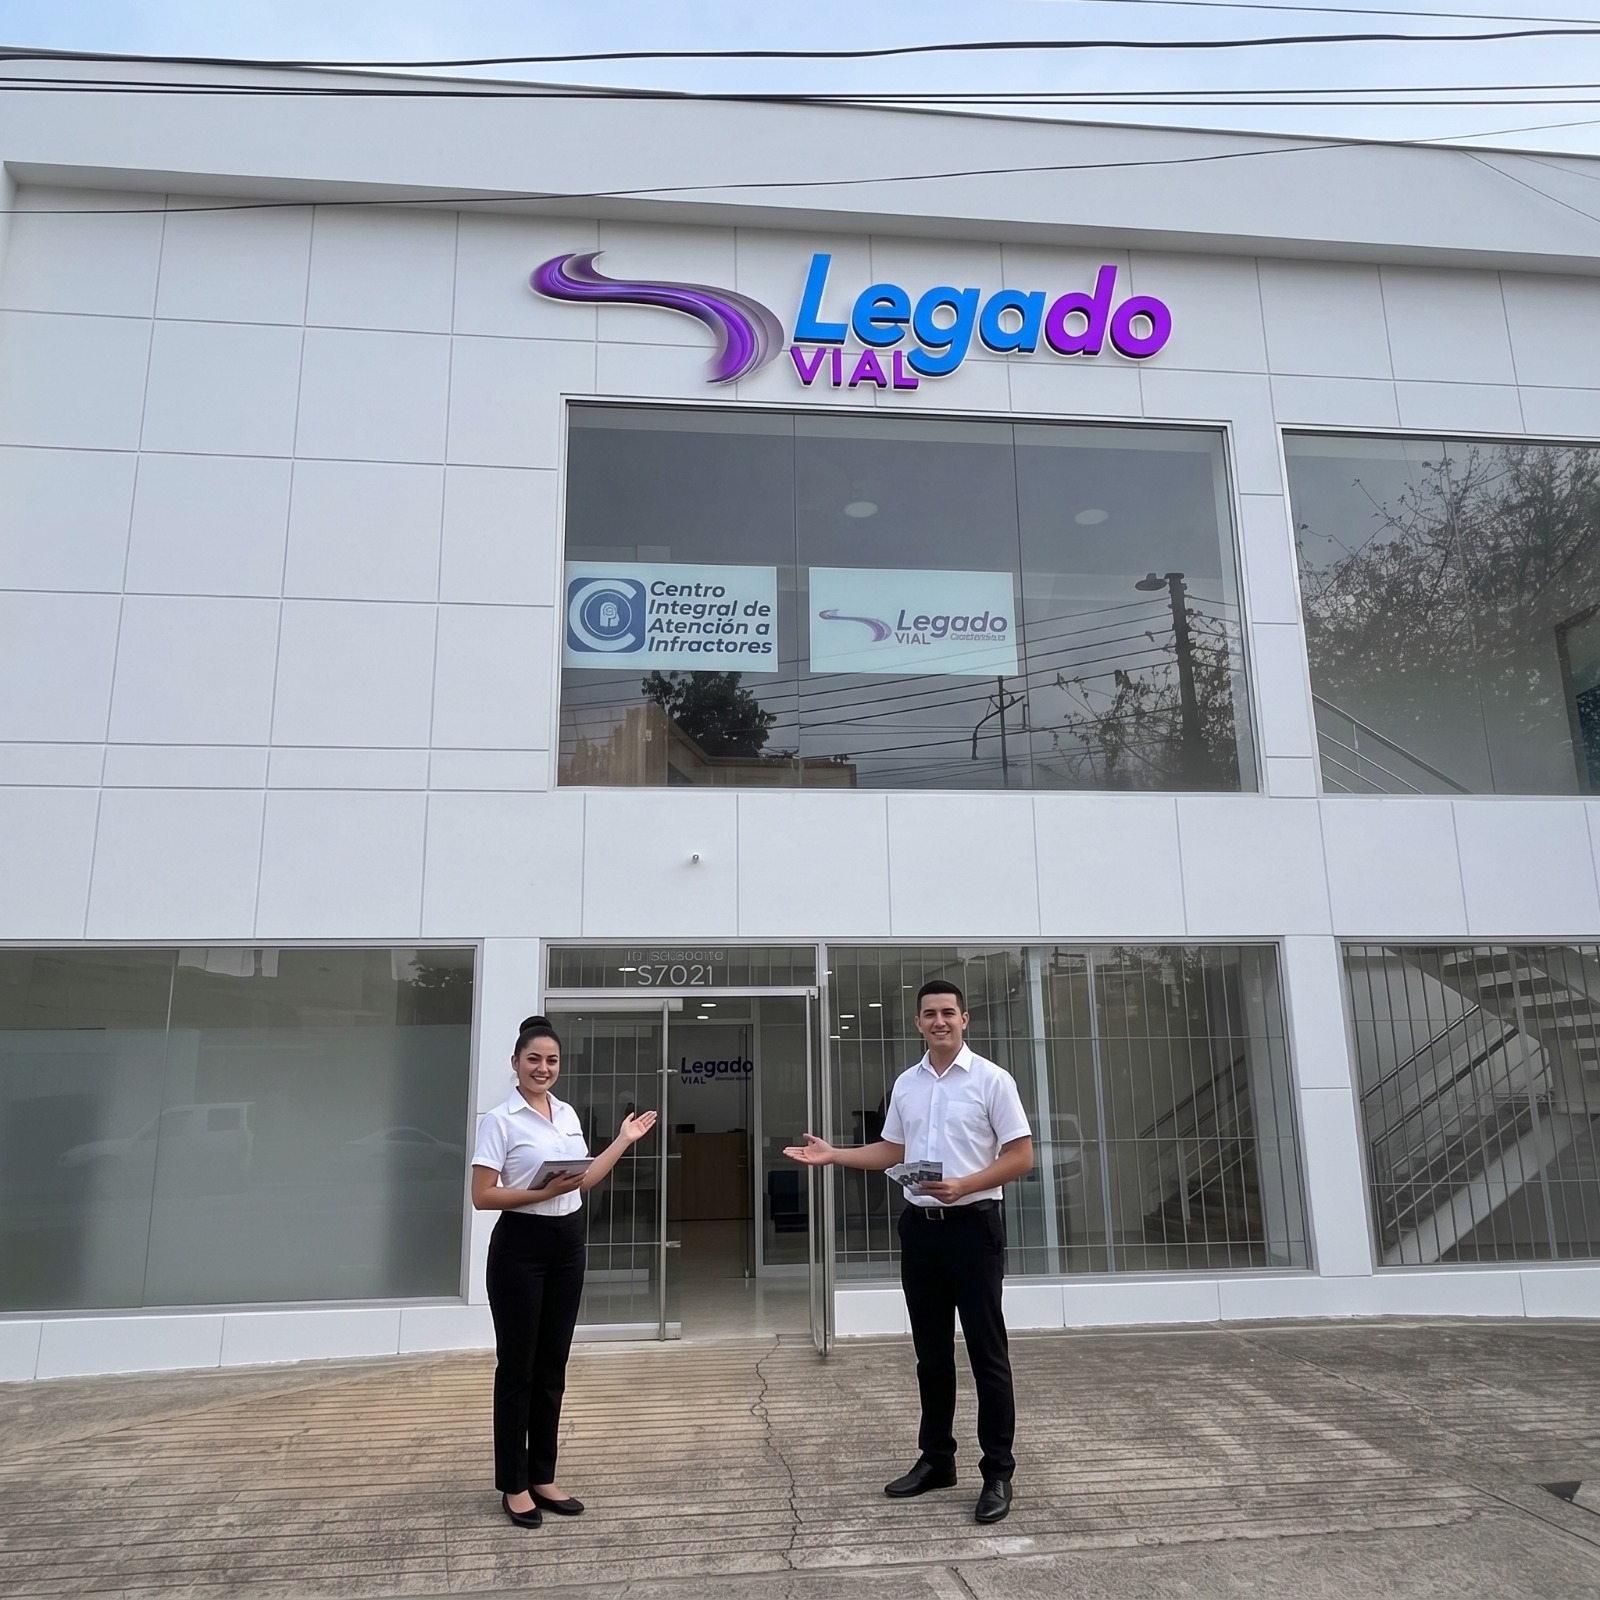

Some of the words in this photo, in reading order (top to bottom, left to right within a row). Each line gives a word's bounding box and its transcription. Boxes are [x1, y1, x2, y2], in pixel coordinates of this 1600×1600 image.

[793, 253, 1172, 376] Legado
[790, 346, 919, 390] VIAL
[650, 581, 726, 597] Centro
[648, 600, 738, 618] Integral
[743, 601, 771, 616] de
[648, 618, 748, 634] Atención
[755, 622, 770, 635] a
[897, 610, 1008, 638] Legado
[648, 636, 772, 653] Infractores
[895, 633, 931, 645] VIAL
[637, 965, 713, 985] S7021
[681, 1056, 753, 1078] Legado
[681, 1076, 706, 1084] VIAL
